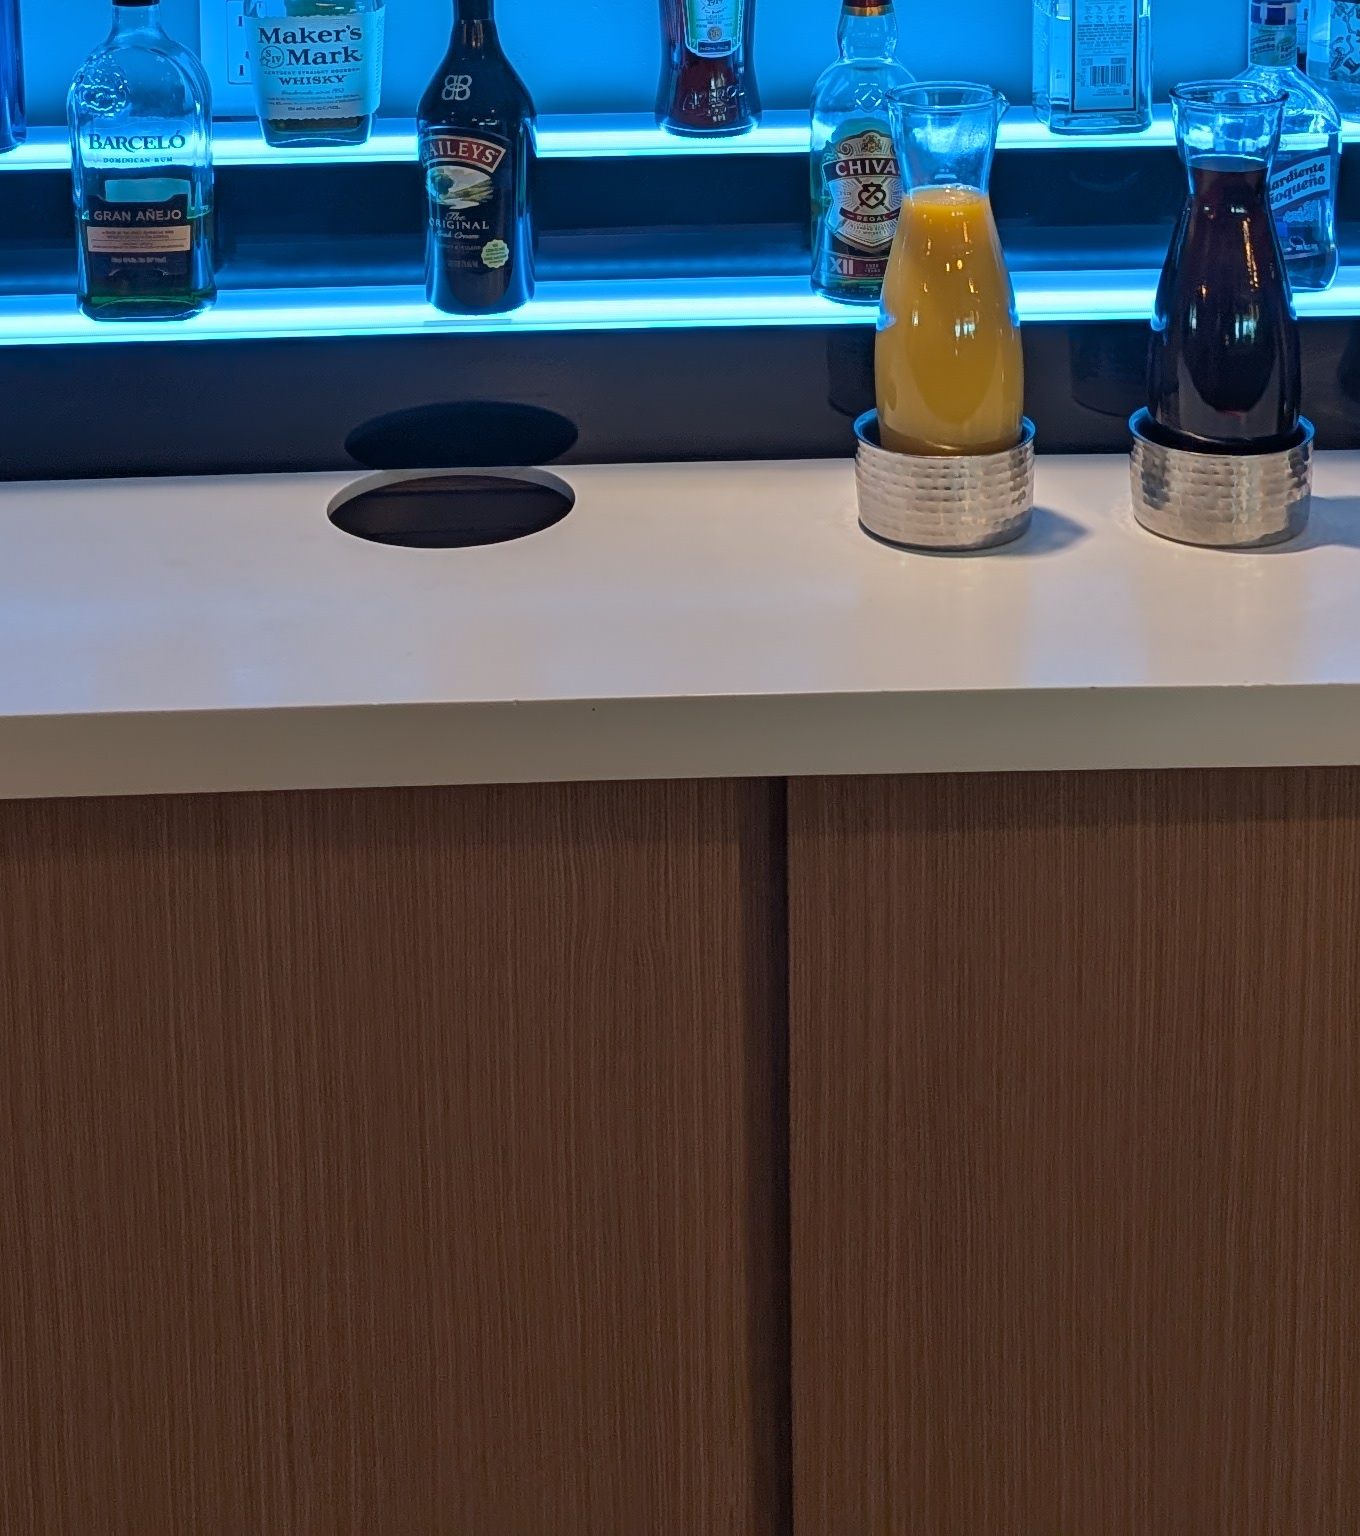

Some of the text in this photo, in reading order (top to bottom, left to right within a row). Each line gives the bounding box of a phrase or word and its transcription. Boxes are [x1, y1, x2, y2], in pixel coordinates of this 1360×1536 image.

[257, 24, 363, 45] Maker's
[286, 45, 362, 66] Mark
[278, 75, 348, 85] WHISKY
[88, 130, 186, 153] BARCELÓ
[422, 140, 497, 164] BAILEYS
[93, 208, 182, 221] GRAN AÑEJO
[429, 217, 490, 230] ORIGINAL
[830, 256, 854, 275] XII
